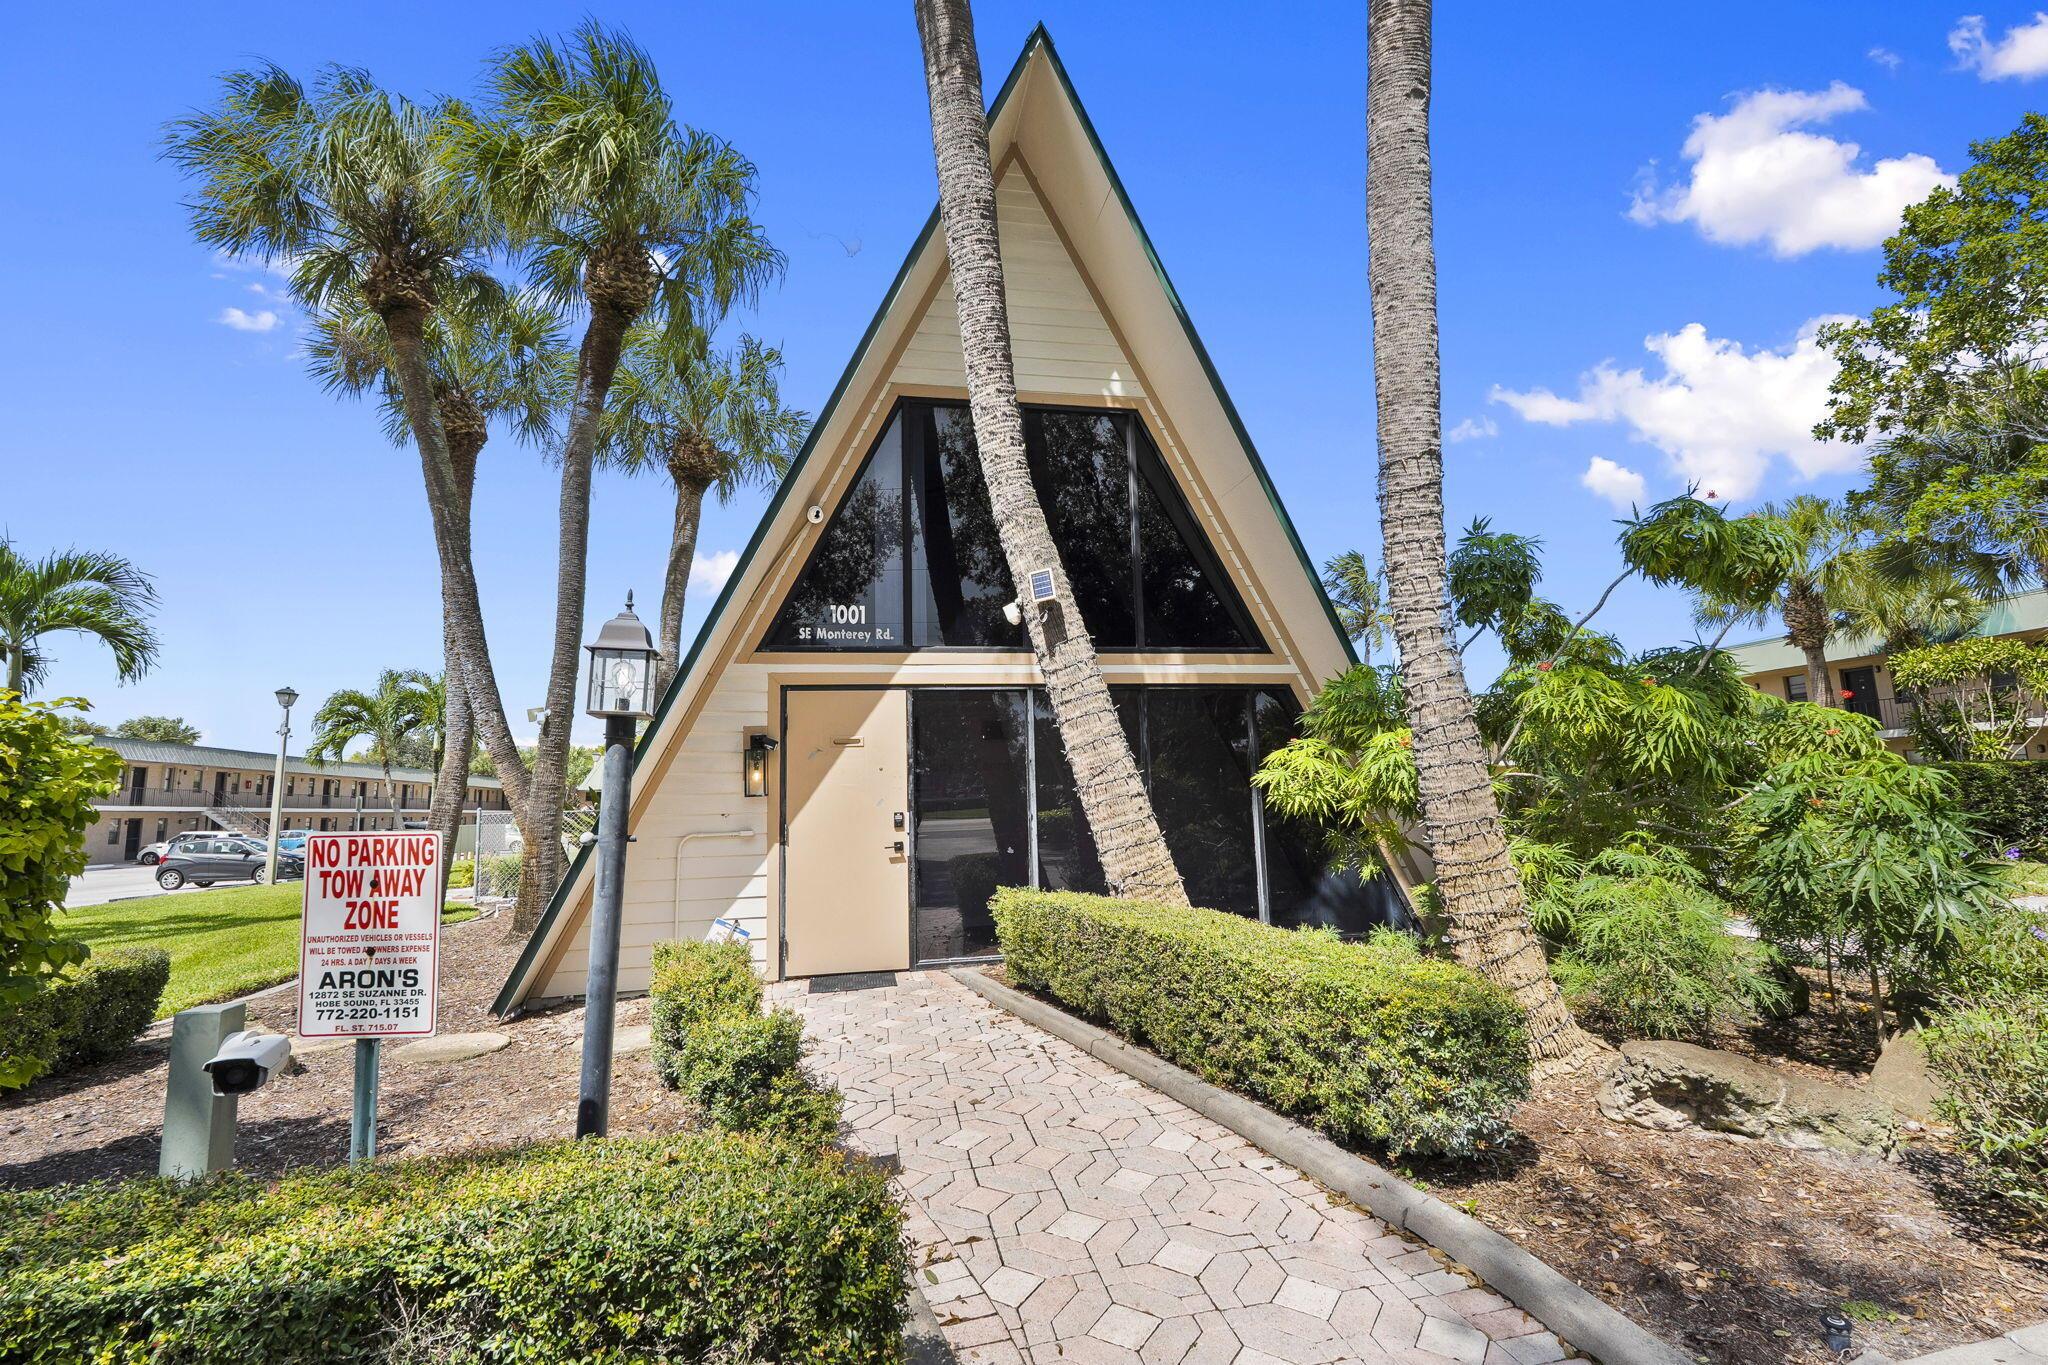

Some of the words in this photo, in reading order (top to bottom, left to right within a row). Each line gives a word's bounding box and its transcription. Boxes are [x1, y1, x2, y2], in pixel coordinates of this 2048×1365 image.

[830, 604, 866, 624] 1001
[799, 628, 812, 640] SE
[816, 628, 872, 642] Monterey
[876, 628, 894, 640] Rd.
[312, 840, 340, 868] NO
[348, 837, 434, 867] PARKING
[319, 870, 364, 898] TOW
[369, 869, 426, 898] AWAY
[344, 900, 399, 930] ZONE
[307, 934, 358, 943] UNAUTHORIZED
[361, 934, 392, 942] VEHICLES
[318, 968, 419, 990] ARON'S
[309, 992, 339, 1000] 12872
[342, 990, 356, 998] SE
[358, 990, 407, 998] SUZANNE
[344, 1000, 378, 1008] SOUND,
[316, 1007, 419, 1020] 772-220-1151
[368, 1024, 398, 1032] 715.07
